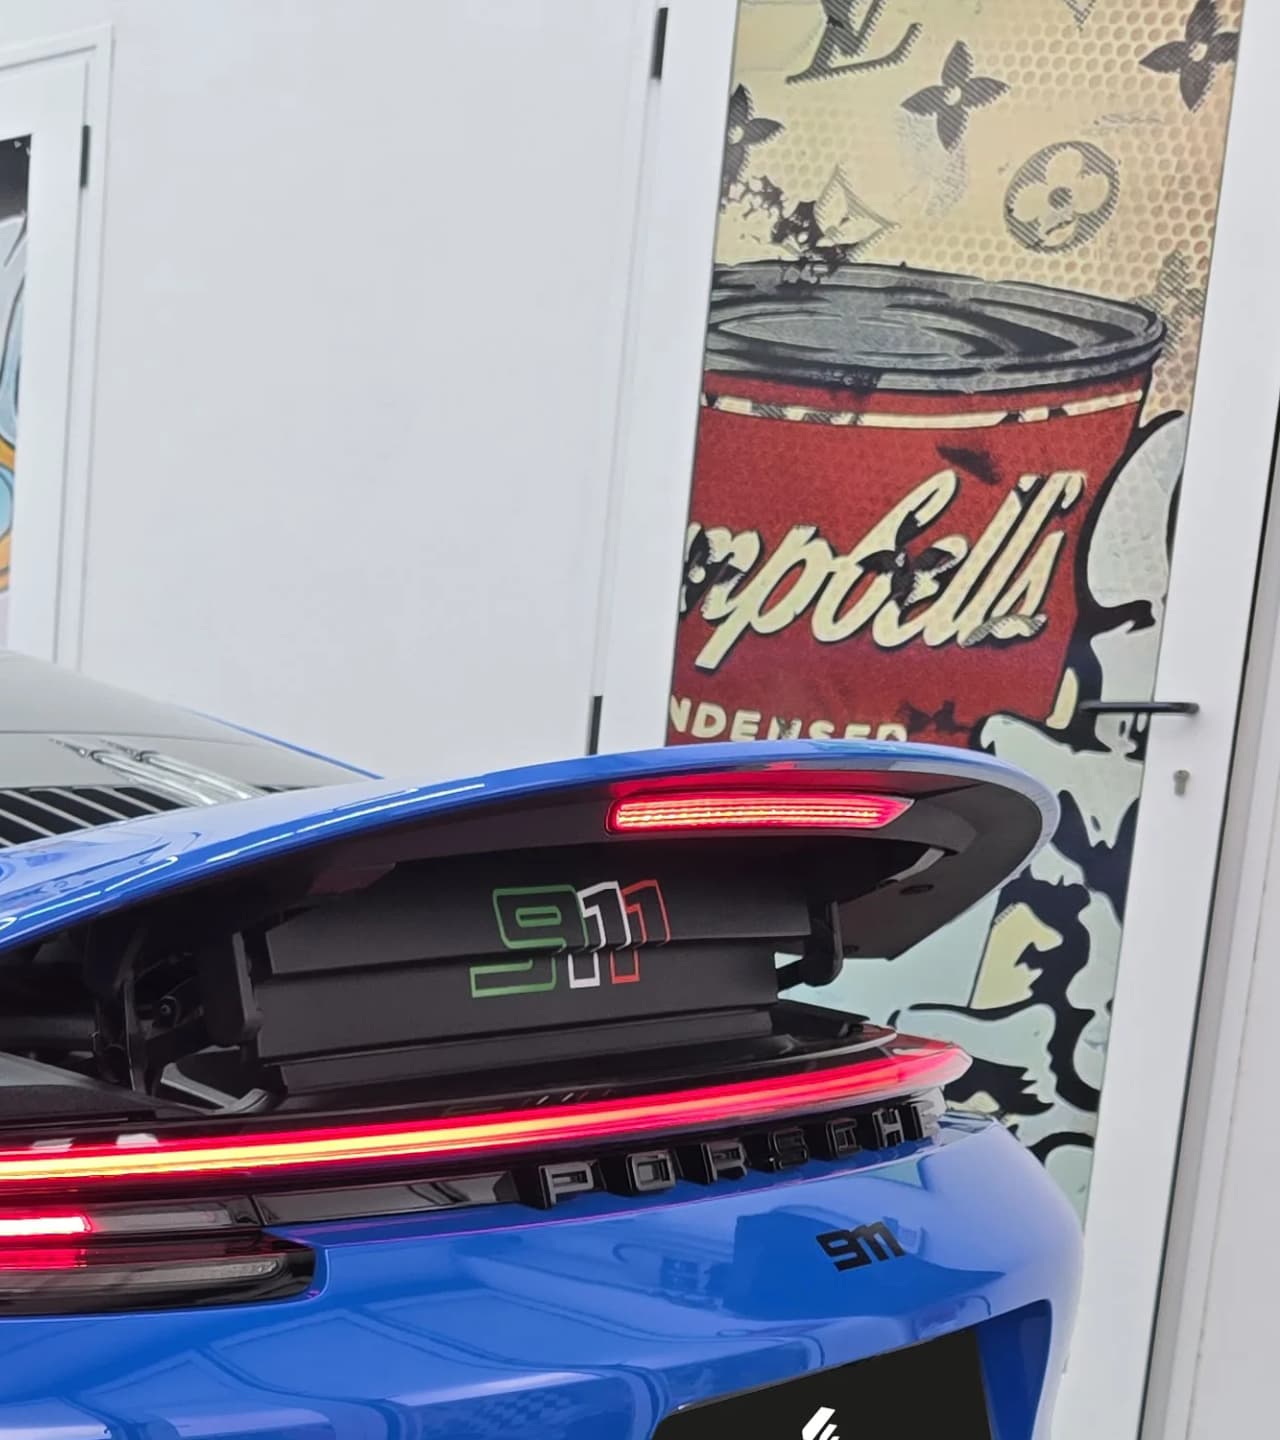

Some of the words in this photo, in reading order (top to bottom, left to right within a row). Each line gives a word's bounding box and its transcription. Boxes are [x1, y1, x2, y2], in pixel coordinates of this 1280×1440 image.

[469, 879, 672, 998] 911
[538, 1101, 939, 1209] PORSCHE
[815, 1221, 907, 1273] 911
